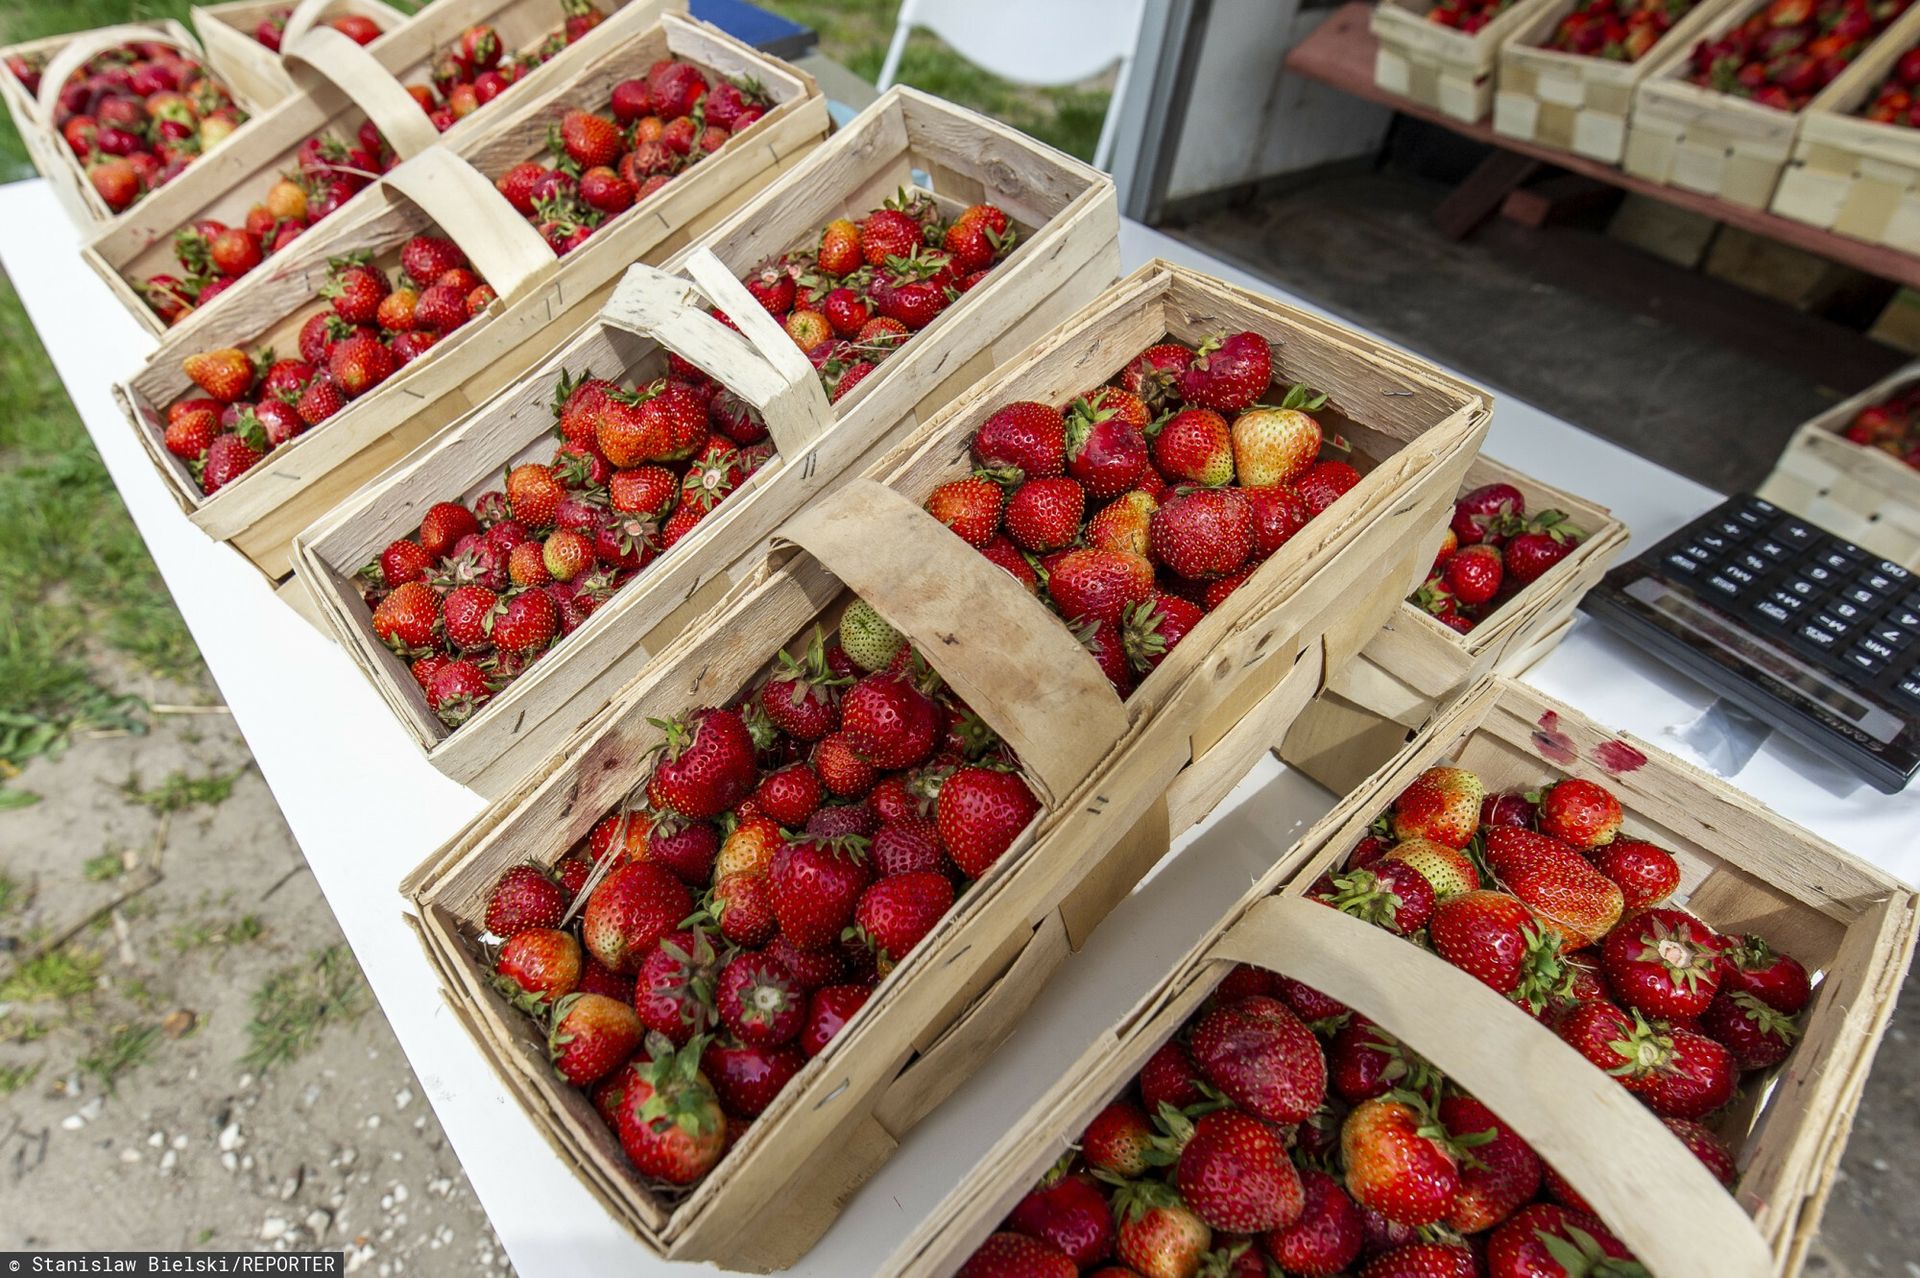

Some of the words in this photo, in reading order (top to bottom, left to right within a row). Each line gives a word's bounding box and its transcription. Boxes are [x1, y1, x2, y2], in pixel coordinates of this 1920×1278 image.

[1828, 555, 1845, 567] 3
[1727, 566, 1752, 581] MU
[1810, 568, 1828, 579] 9
[1881, 561, 1908, 577] 00
[1794, 582, 1812, 593] 6
[1870, 575, 1889, 588] 2
[1776, 592, 1801, 608] M+
[1854, 590, 1873, 602] 5
[1838, 604, 1856, 617] 8
[1901, 614, 1919, 624] 4
[1882, 631, 1900, 642] 7
[1865, 639, 1891, 656] MR
[1903, 682, 1920, 696] FF
